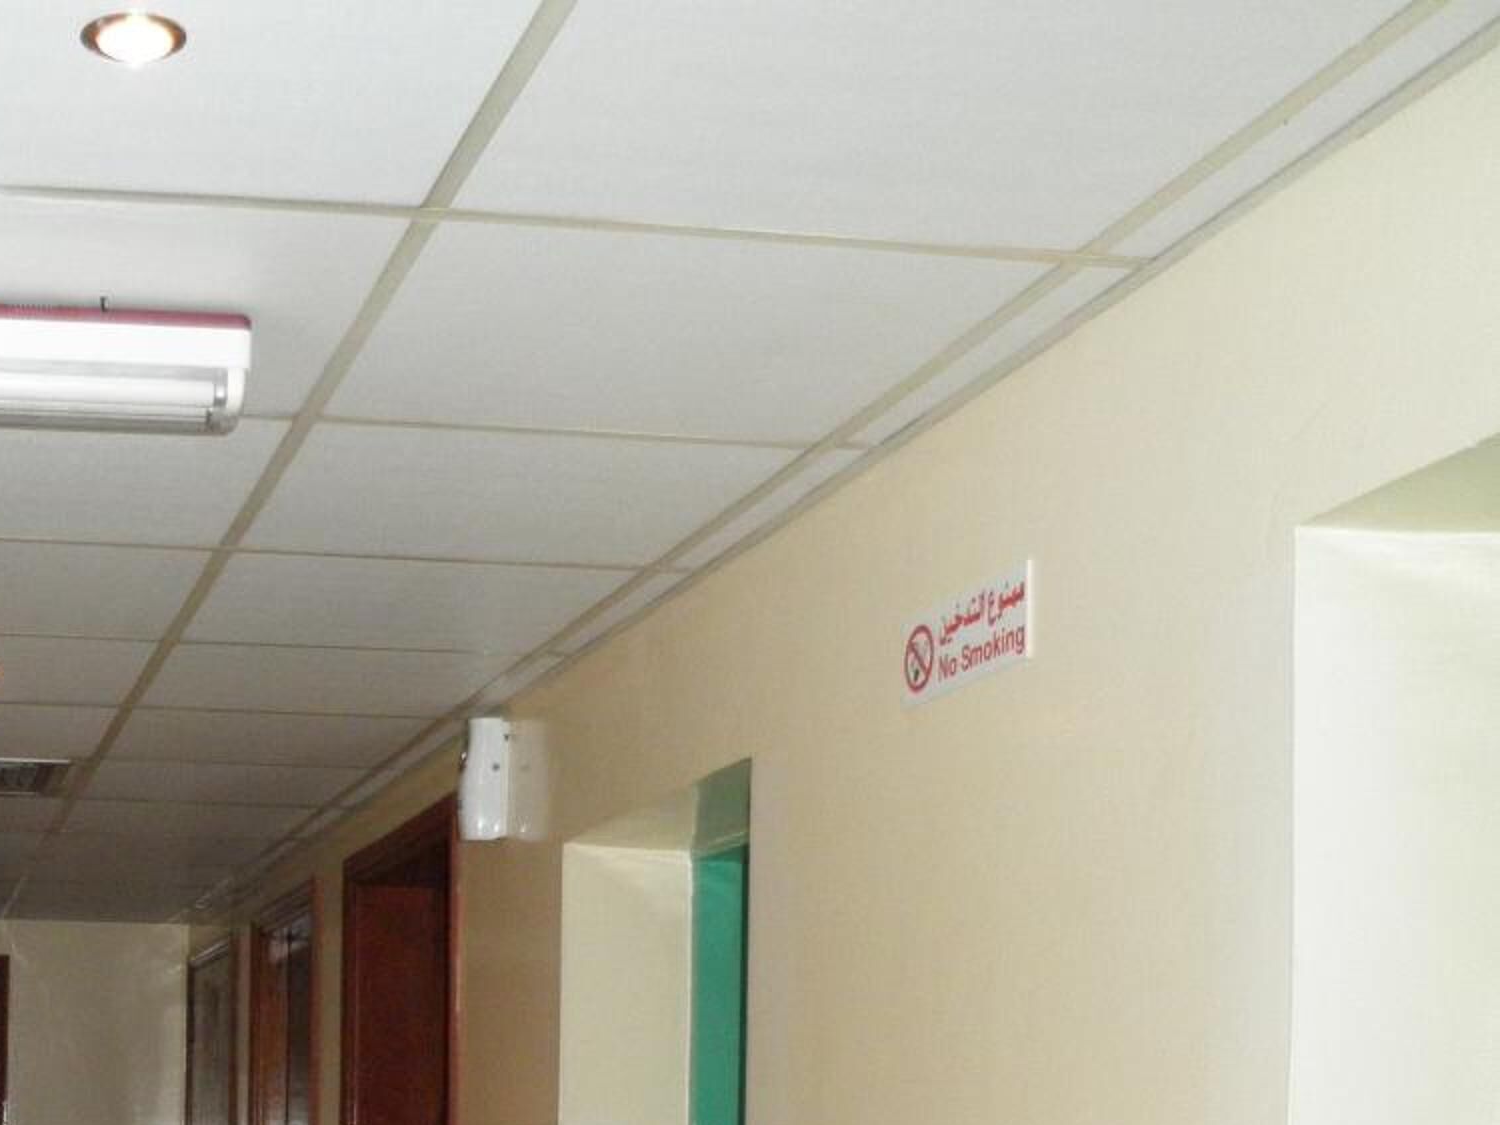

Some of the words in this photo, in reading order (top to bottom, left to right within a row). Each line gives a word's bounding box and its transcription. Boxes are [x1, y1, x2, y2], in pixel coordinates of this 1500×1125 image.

[938, 588, 986, 646] التدخين
[988, 580, 1025, 626] ممنوع
[937, 654, 957, 683] No
[961, 625, 1025, 672] Smoking
